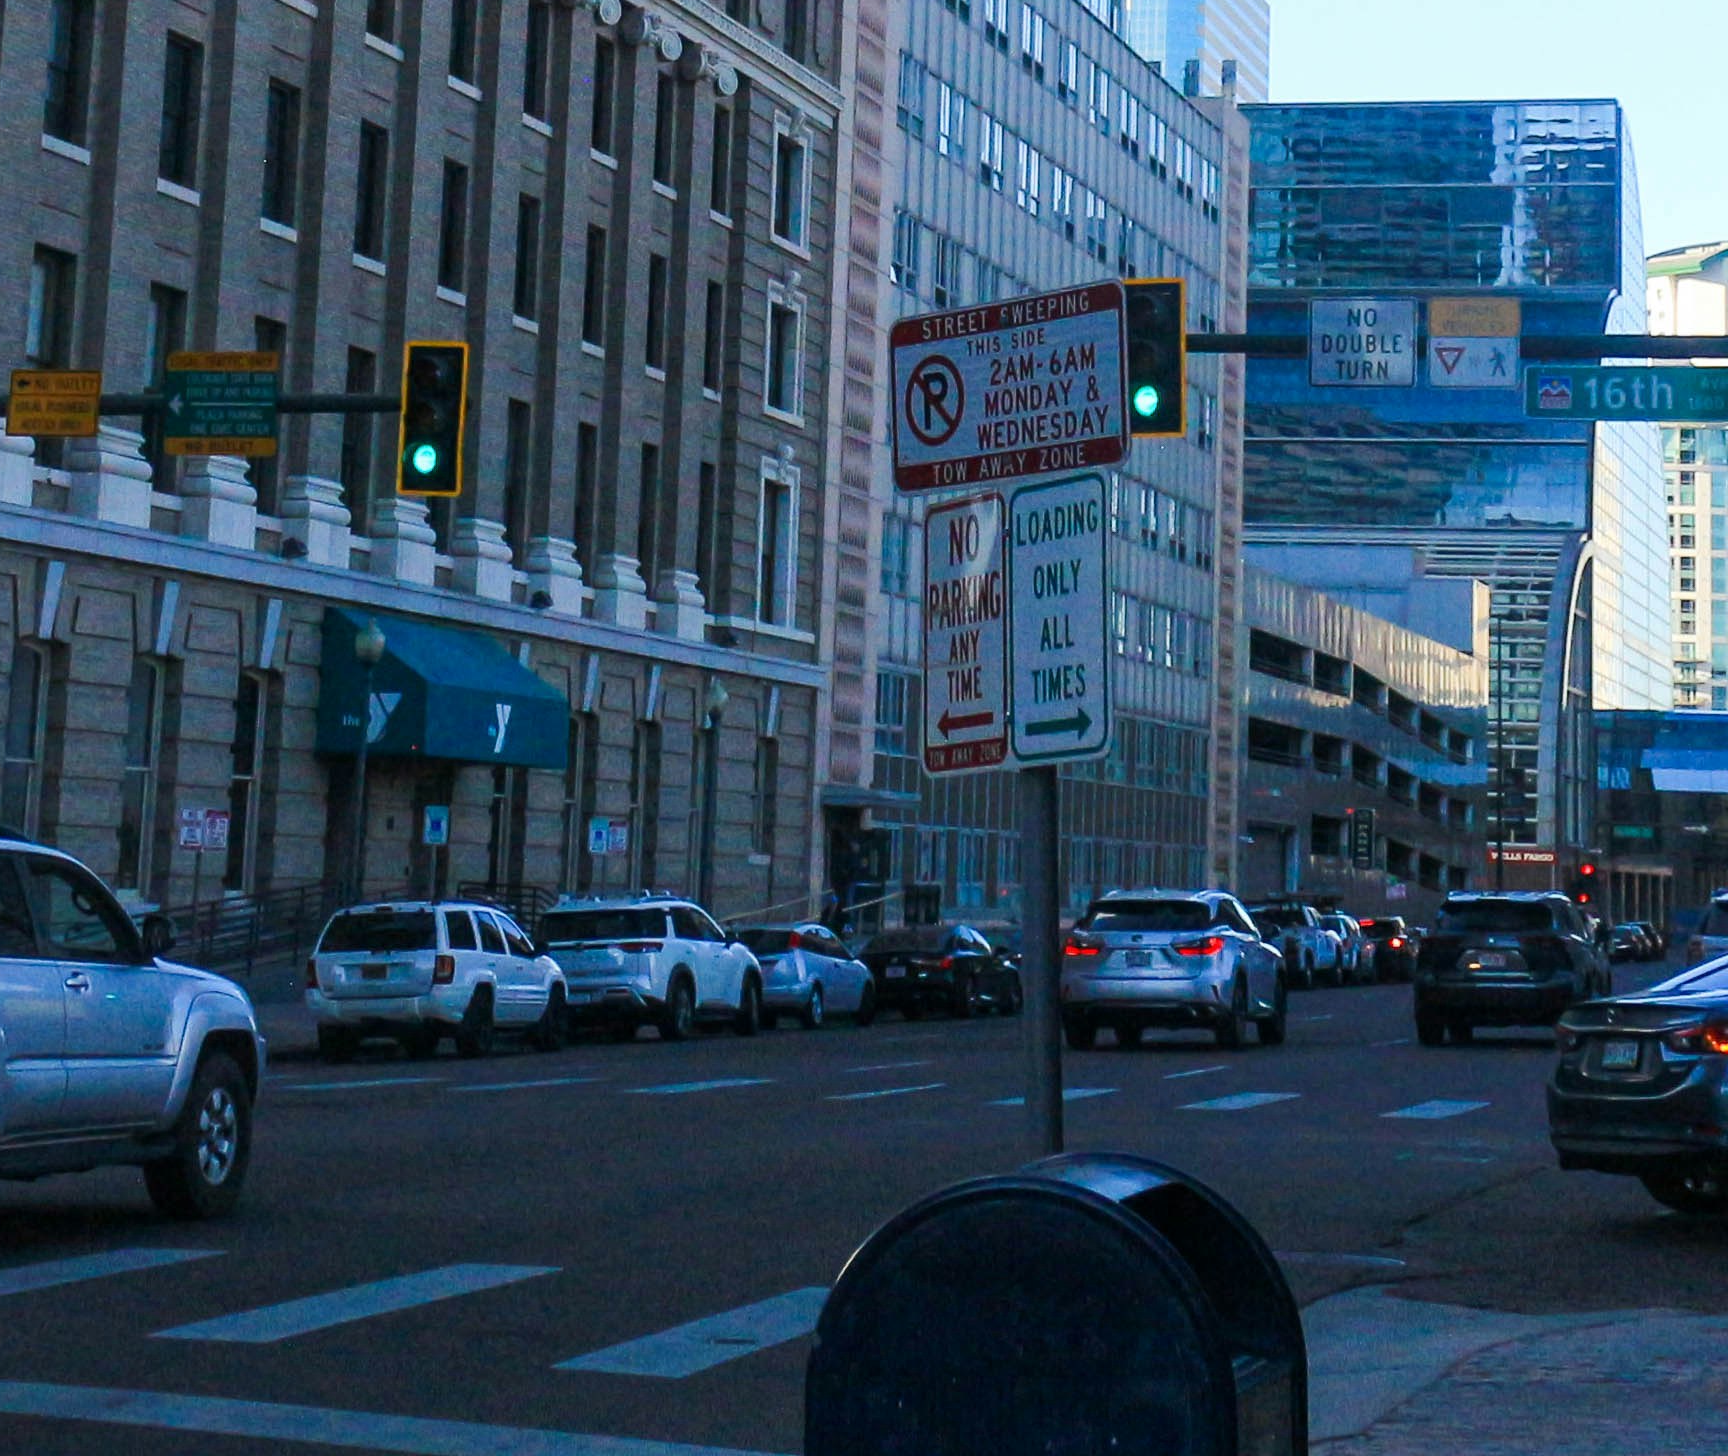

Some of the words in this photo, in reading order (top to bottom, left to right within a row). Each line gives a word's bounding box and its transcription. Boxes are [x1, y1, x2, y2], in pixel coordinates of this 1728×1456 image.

[922, 310, 988, 340] STREET
[1347, 308, 1377, 327] NO
[967, 337, 1001, 356] THIS
[1011, 328, 1045, 349] SIDE
[1322, 334, 1402, 354] DOUBLE
[1336, 360, 1389, 380] TURN
[985, 379, 1073, 418] MONDAY
[1086, 375, 1100, 403] &
[1583, 377, 1673, 410] 16th
[977, 405, 1109, 451] WEDNESDAY
[933, 462, 968, 485] TOW
[979, 453, 1027, 480] AWAY
[1039, 445, 1086, 470] ZONE
[949, 514, 979, 566] NO
[1016, 499, 1098, 547] LOADING
[1033, 559, 1081, 599] ONLY
[929, 571, 1001, 631] PARKING
[949, 629, 980, 665] ANY
[1040, 614, 1075, 652] ALL
[947, 666, 983, 704] TIME
[1032, 663, 1086, 704] TIMES
[930, 751, 946, 767] TOW
[952, 746, 972, 763] AWAY
[979, 741, 1002, 760] ZONE
